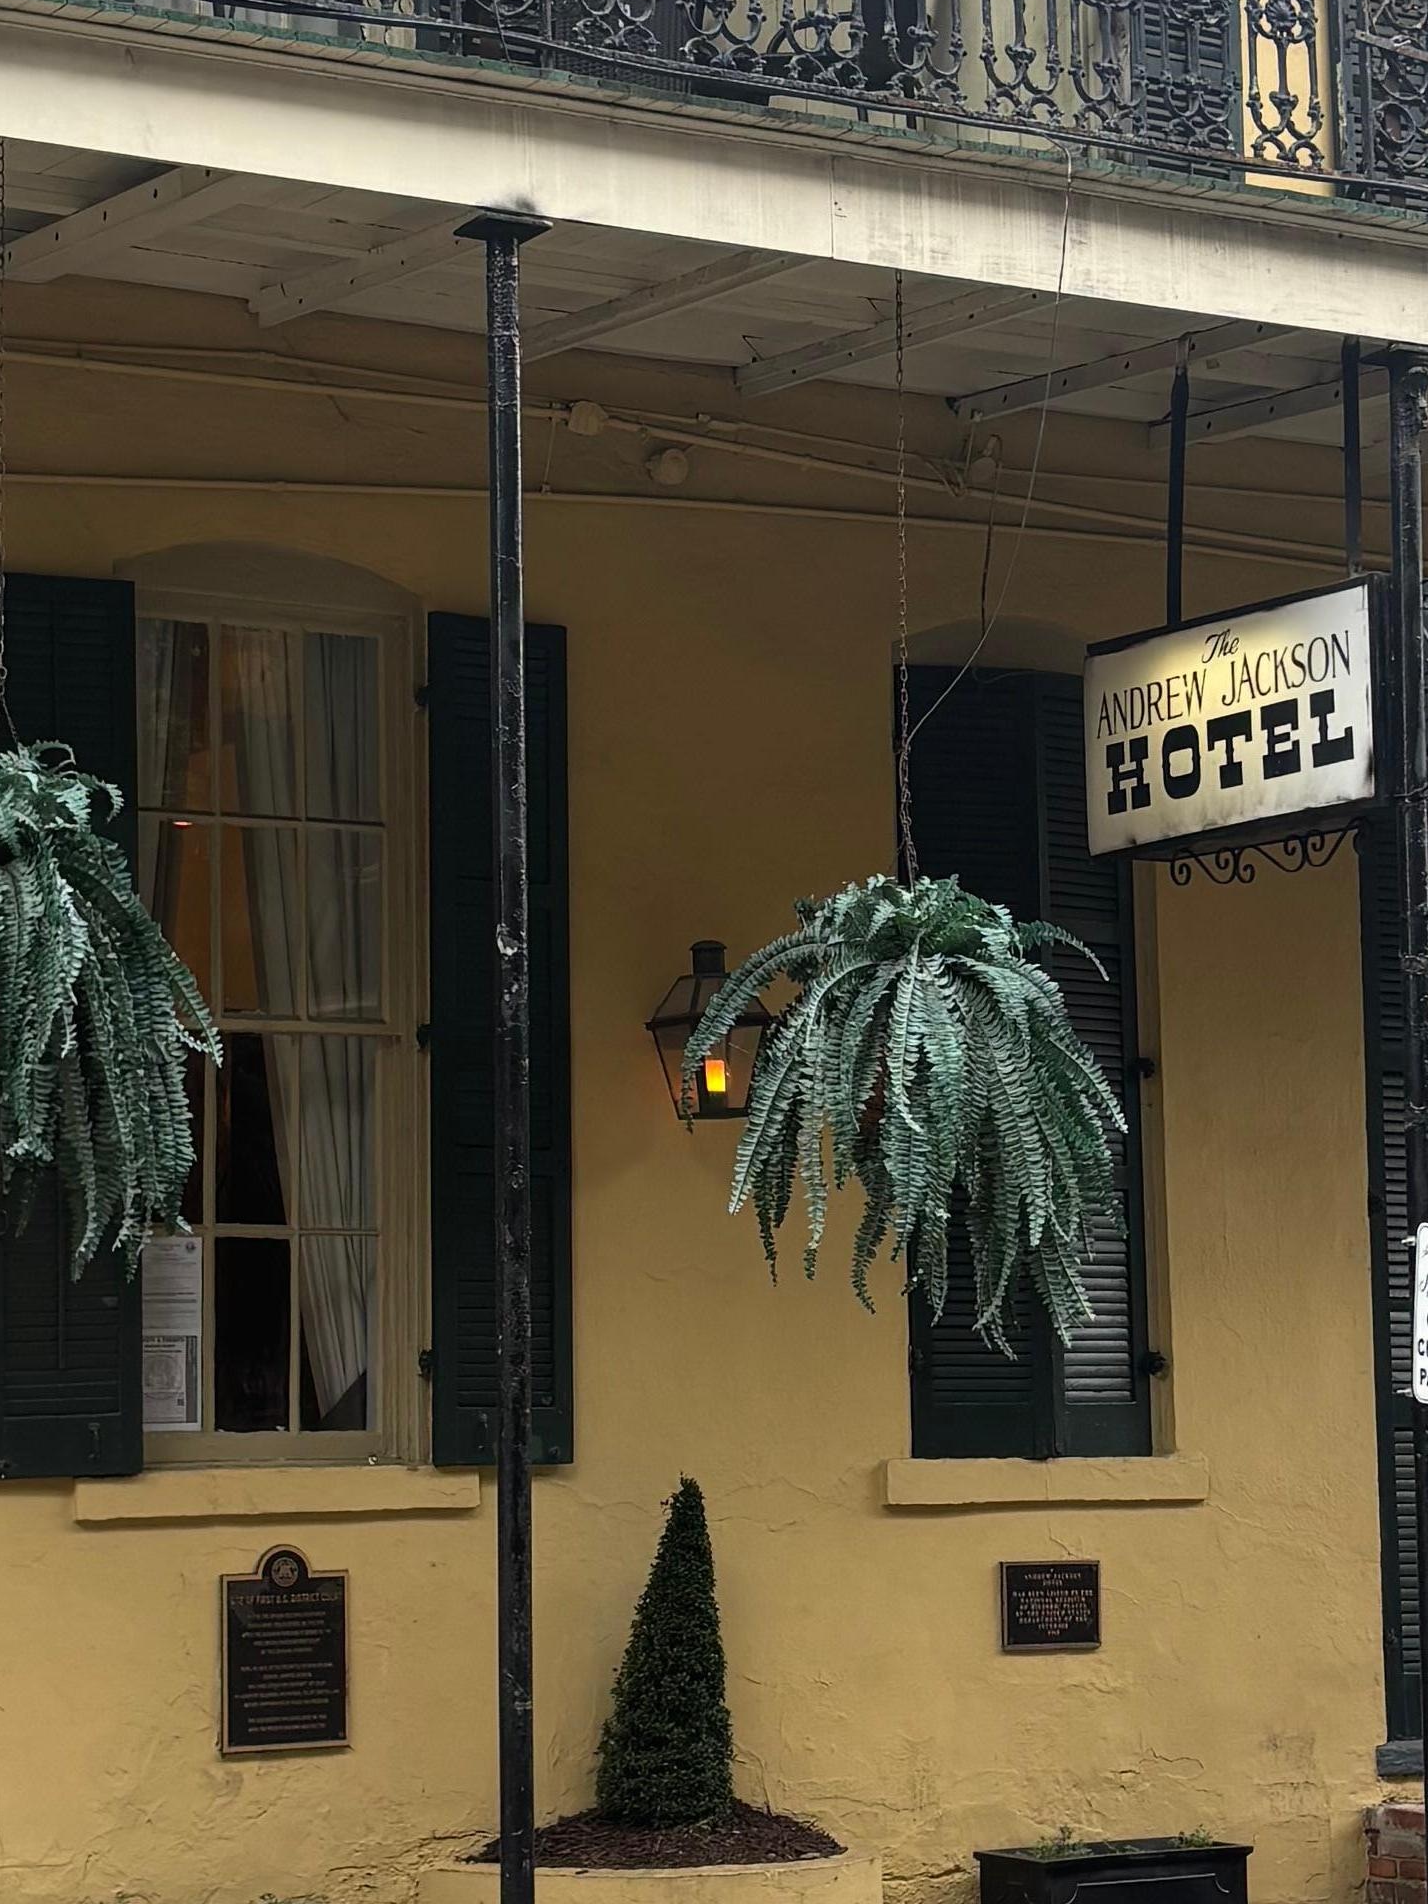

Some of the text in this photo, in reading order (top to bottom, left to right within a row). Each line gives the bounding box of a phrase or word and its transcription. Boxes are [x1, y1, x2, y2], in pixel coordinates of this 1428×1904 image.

[1096, 630, 1352, 739] ANDREW JACKSON
[1201, 629, 1239, 664] The
[1105, 688, 1355, 816] HOTEL
